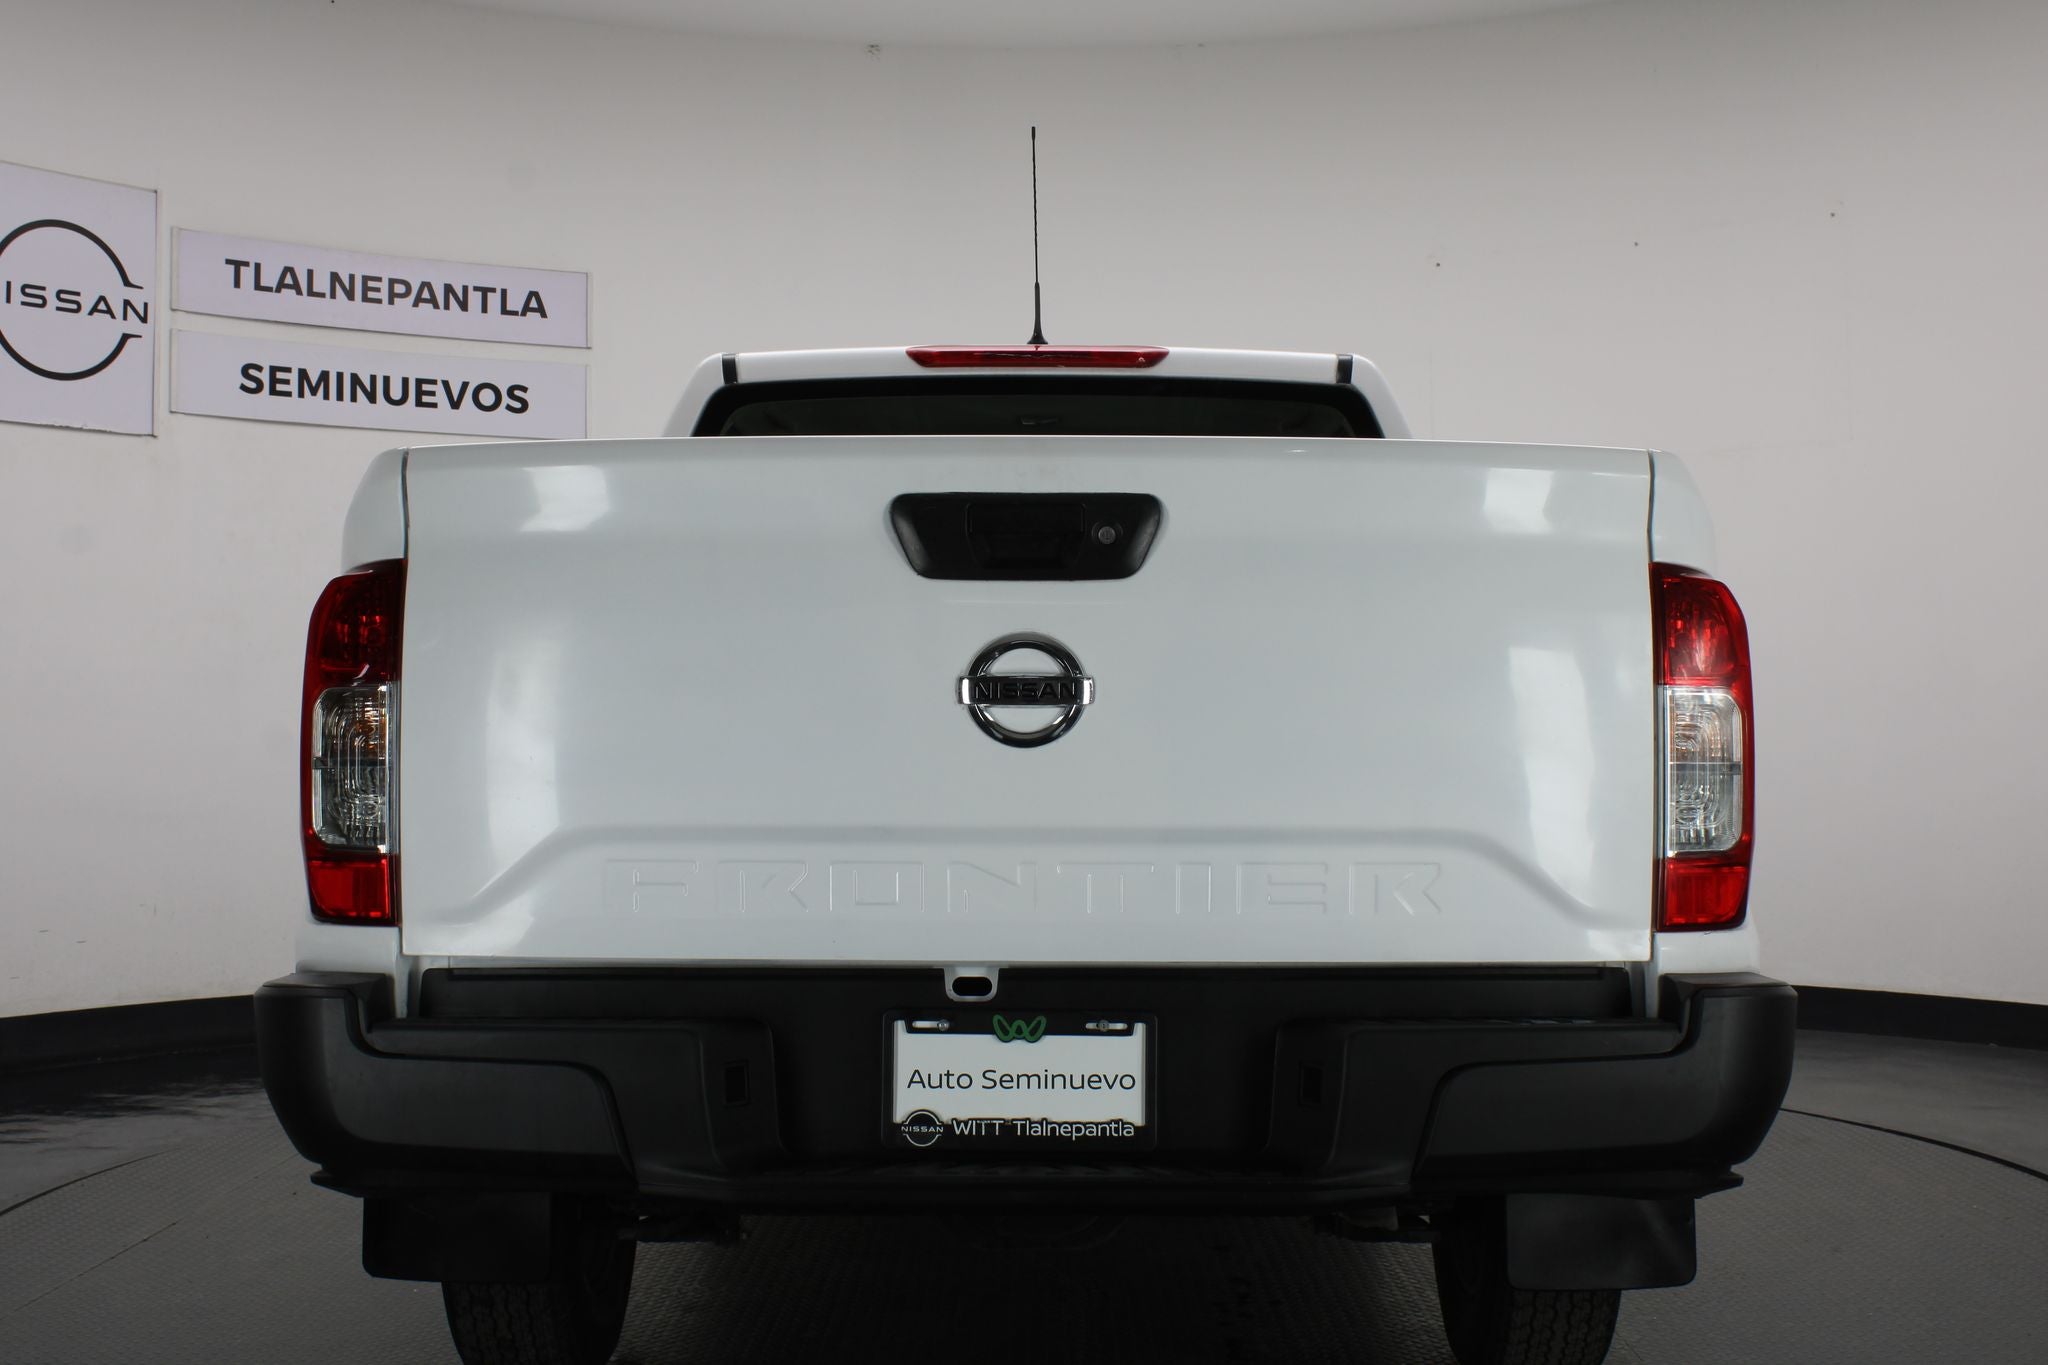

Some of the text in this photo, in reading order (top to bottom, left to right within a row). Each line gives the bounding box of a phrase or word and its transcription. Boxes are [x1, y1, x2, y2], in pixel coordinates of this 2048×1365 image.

[4, 280, 149, 324] ISSAN
[224, 258, 548, 319] TLALNEPANTLA
[238, 362, 530, 415] SEMINUEVOS
[974, 681, 1076, 700] NISSAN
[604, 858, 1443, 916] FRONTIER
[907, 1069, 1136, 1090] Auto Seminuevo
[900, 1125, 944, 1133] NISSAN
[952, 1120, 1136, 1141] WITT Tlalnepantla
